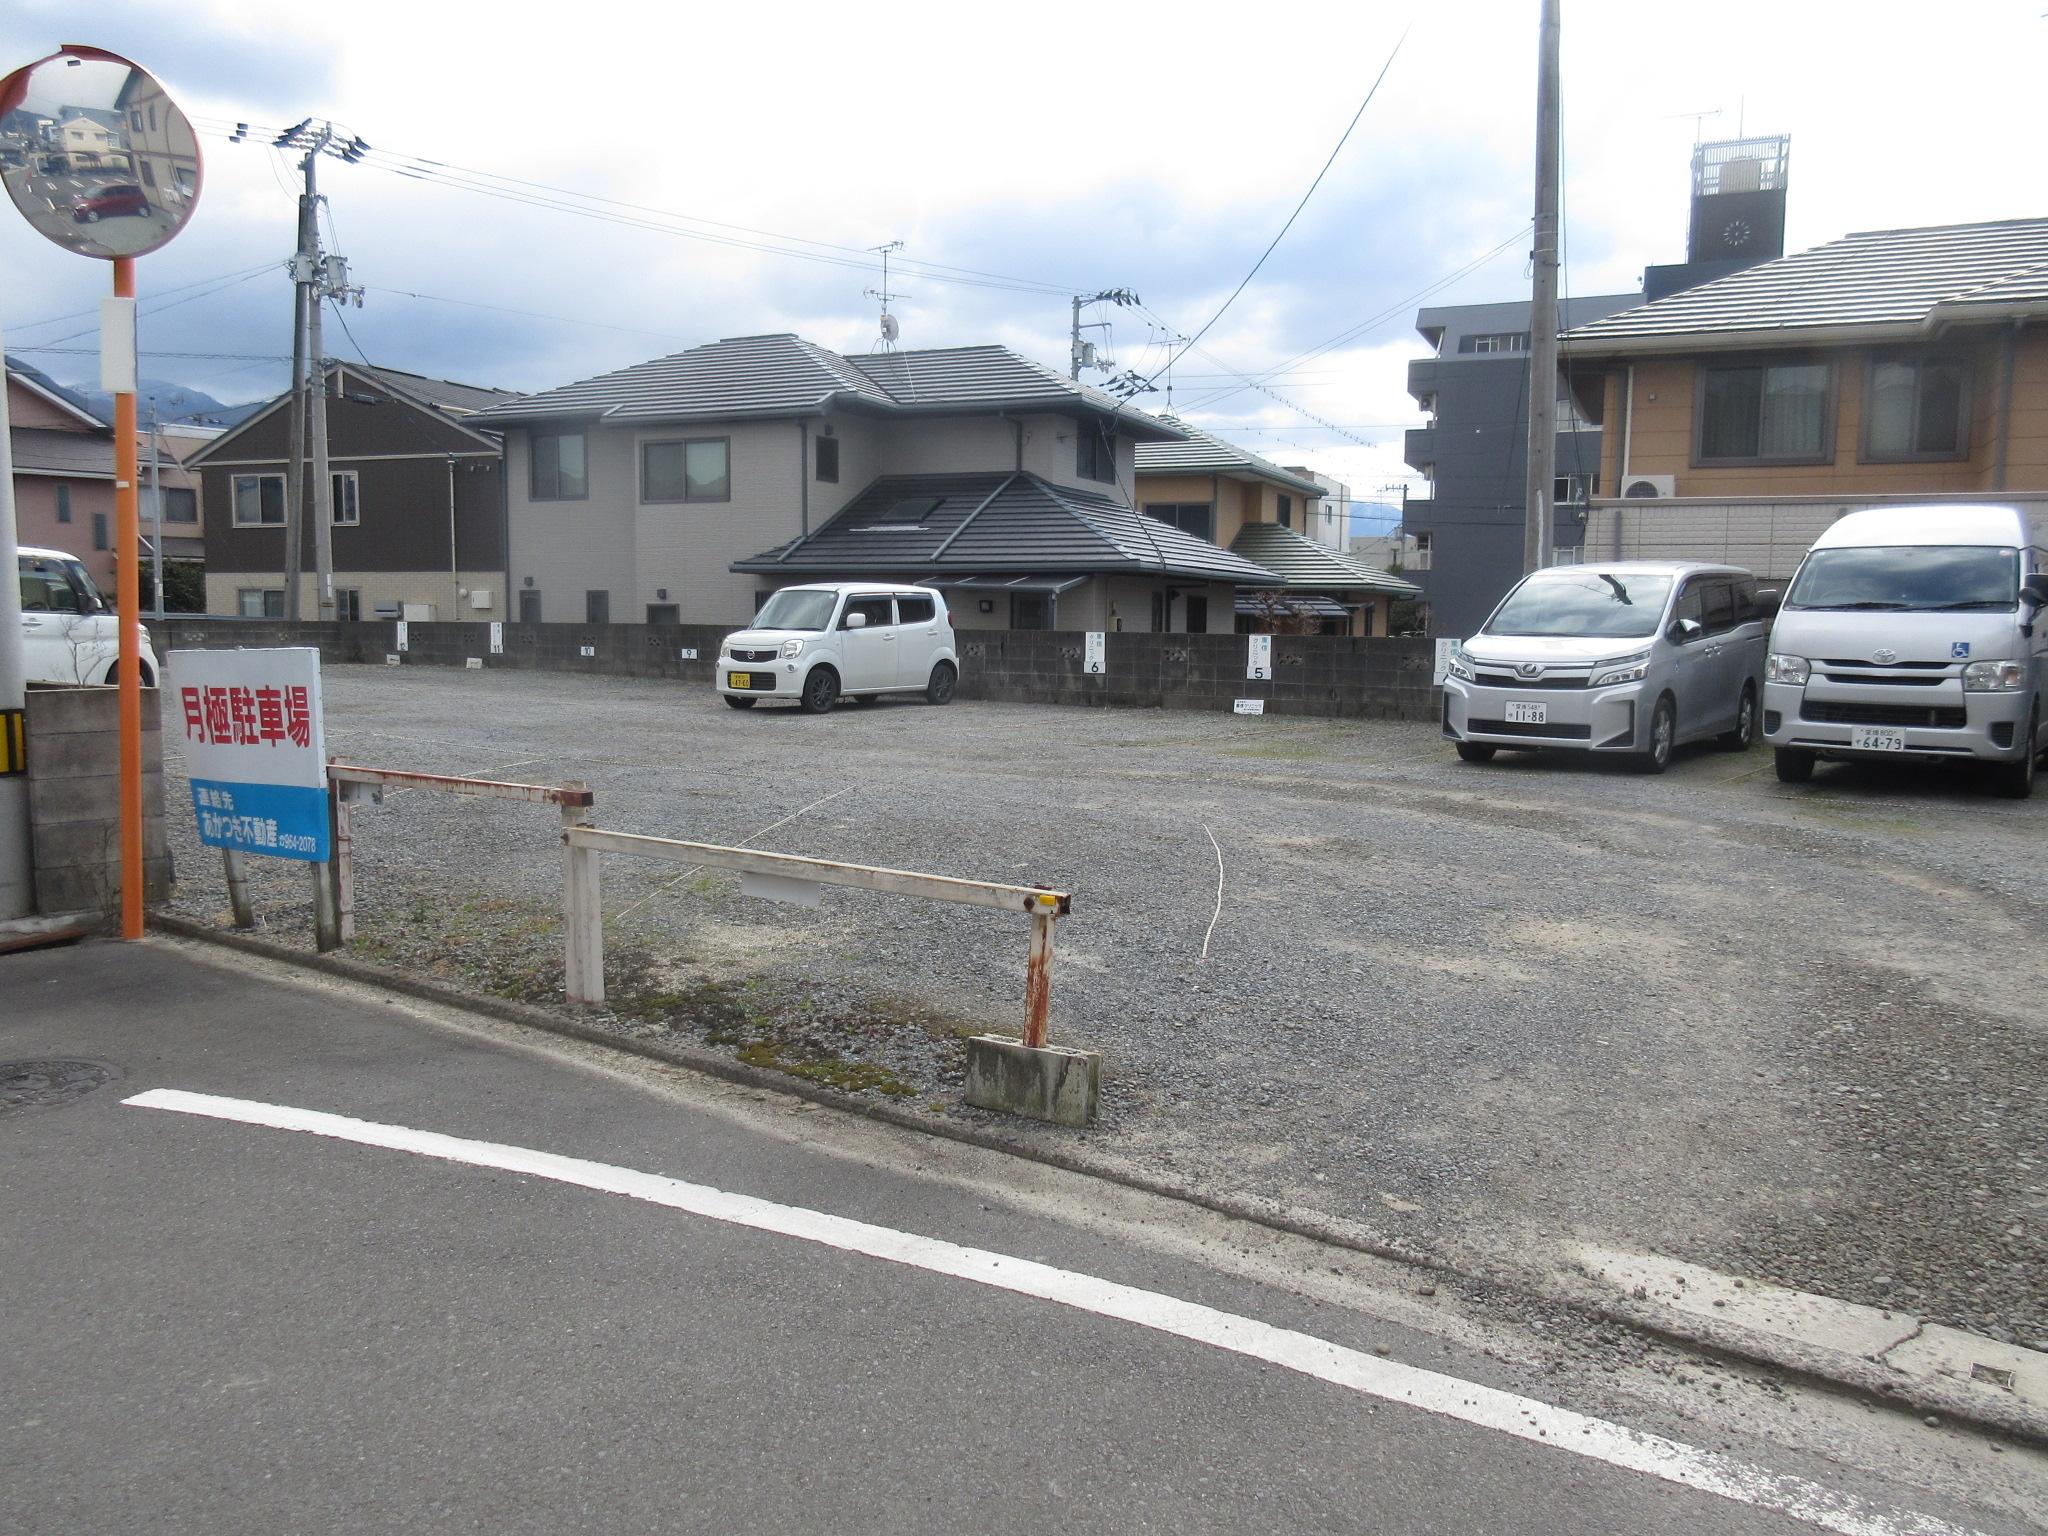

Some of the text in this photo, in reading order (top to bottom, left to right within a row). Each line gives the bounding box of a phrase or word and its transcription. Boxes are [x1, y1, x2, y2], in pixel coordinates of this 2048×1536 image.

[686, 649, 692, 659] 9
[1091, 661, 1099, 673] 6
[1254, 667, 1264, 679] 5
[181, 685, 312, 748] 月極駐車場
[1515, 710, 1544, 722] 11-88
[1863, 737, 1901, 750] 64-79
[197, 788, 234, 810] 連絡先
[201, 810, 278, 848] あかつき不動産
